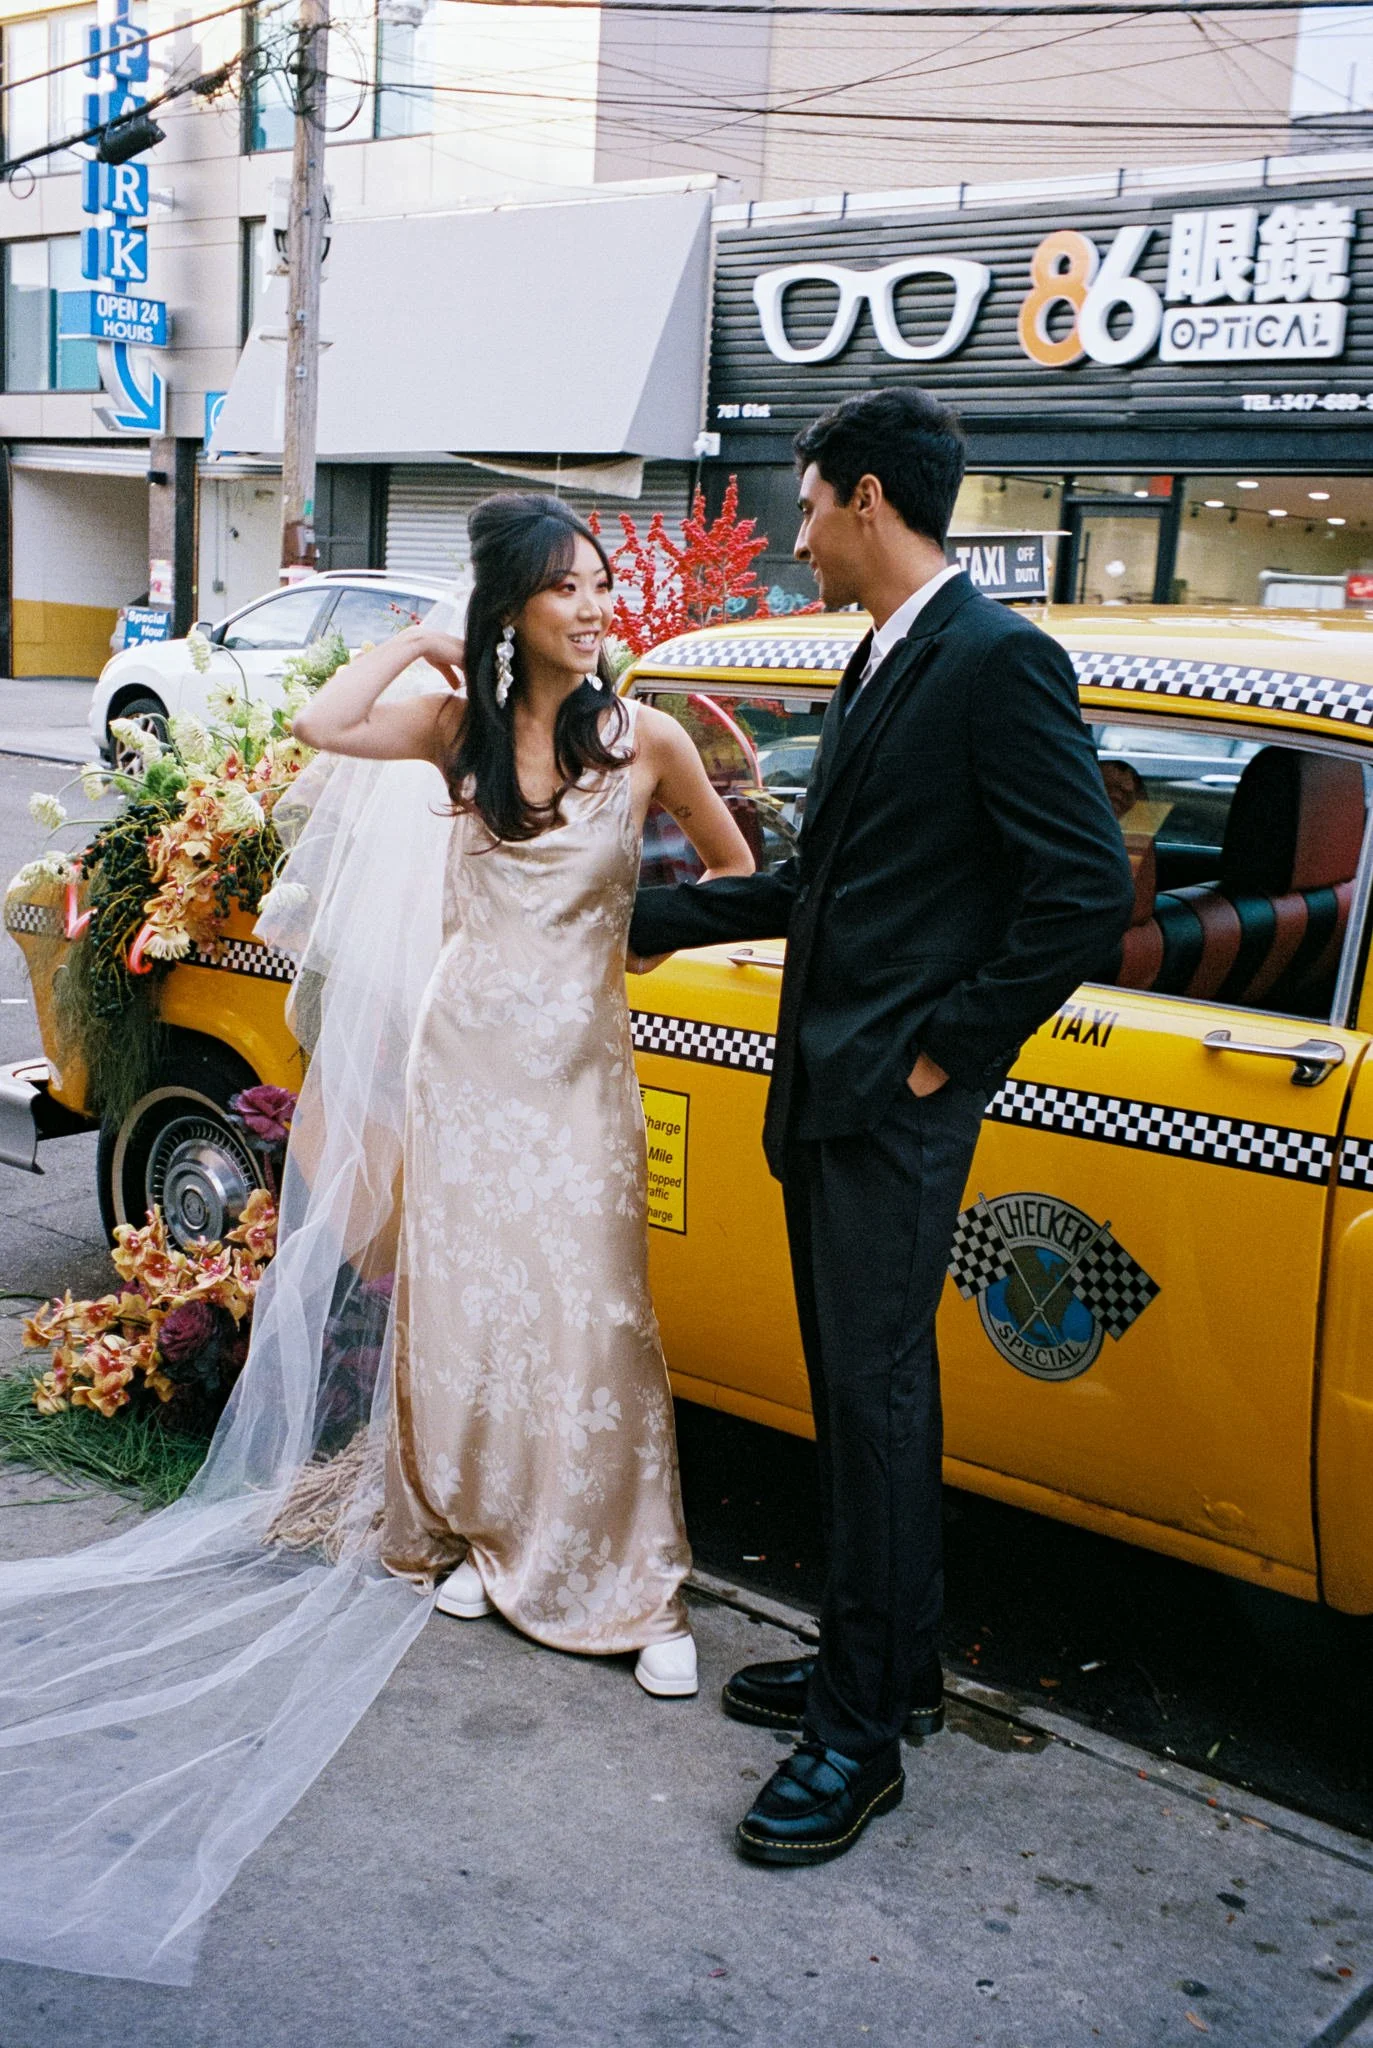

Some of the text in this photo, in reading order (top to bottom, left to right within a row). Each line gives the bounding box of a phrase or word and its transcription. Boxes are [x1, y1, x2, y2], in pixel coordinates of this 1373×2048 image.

[1166, 201, 1356, 304] 眼鏡
[1018, 225, 1163, 367] 86
[96, 294, 159, 325] OPEN 24
[103, 319, 154, 343] HOURS
[956, 546, 1006, 586] TAXI
[1016, 546, 1036, 562] OFF
[1015, 567, 1040, 583] DUTY
[128, 610, 167, 624] Special
[141, 625, 165, 638] Hour
[1051, 1003, 1119, 1048] TAXI
[645, 1114, 681, 1137] harge
[648, 1146, 673, 1164] Mile
[648, 1205, 673, 1223] harge
[994, 1200, 1094, 1256] CHECKER
[999, 1323, 1081, 1367] SPECIAL
